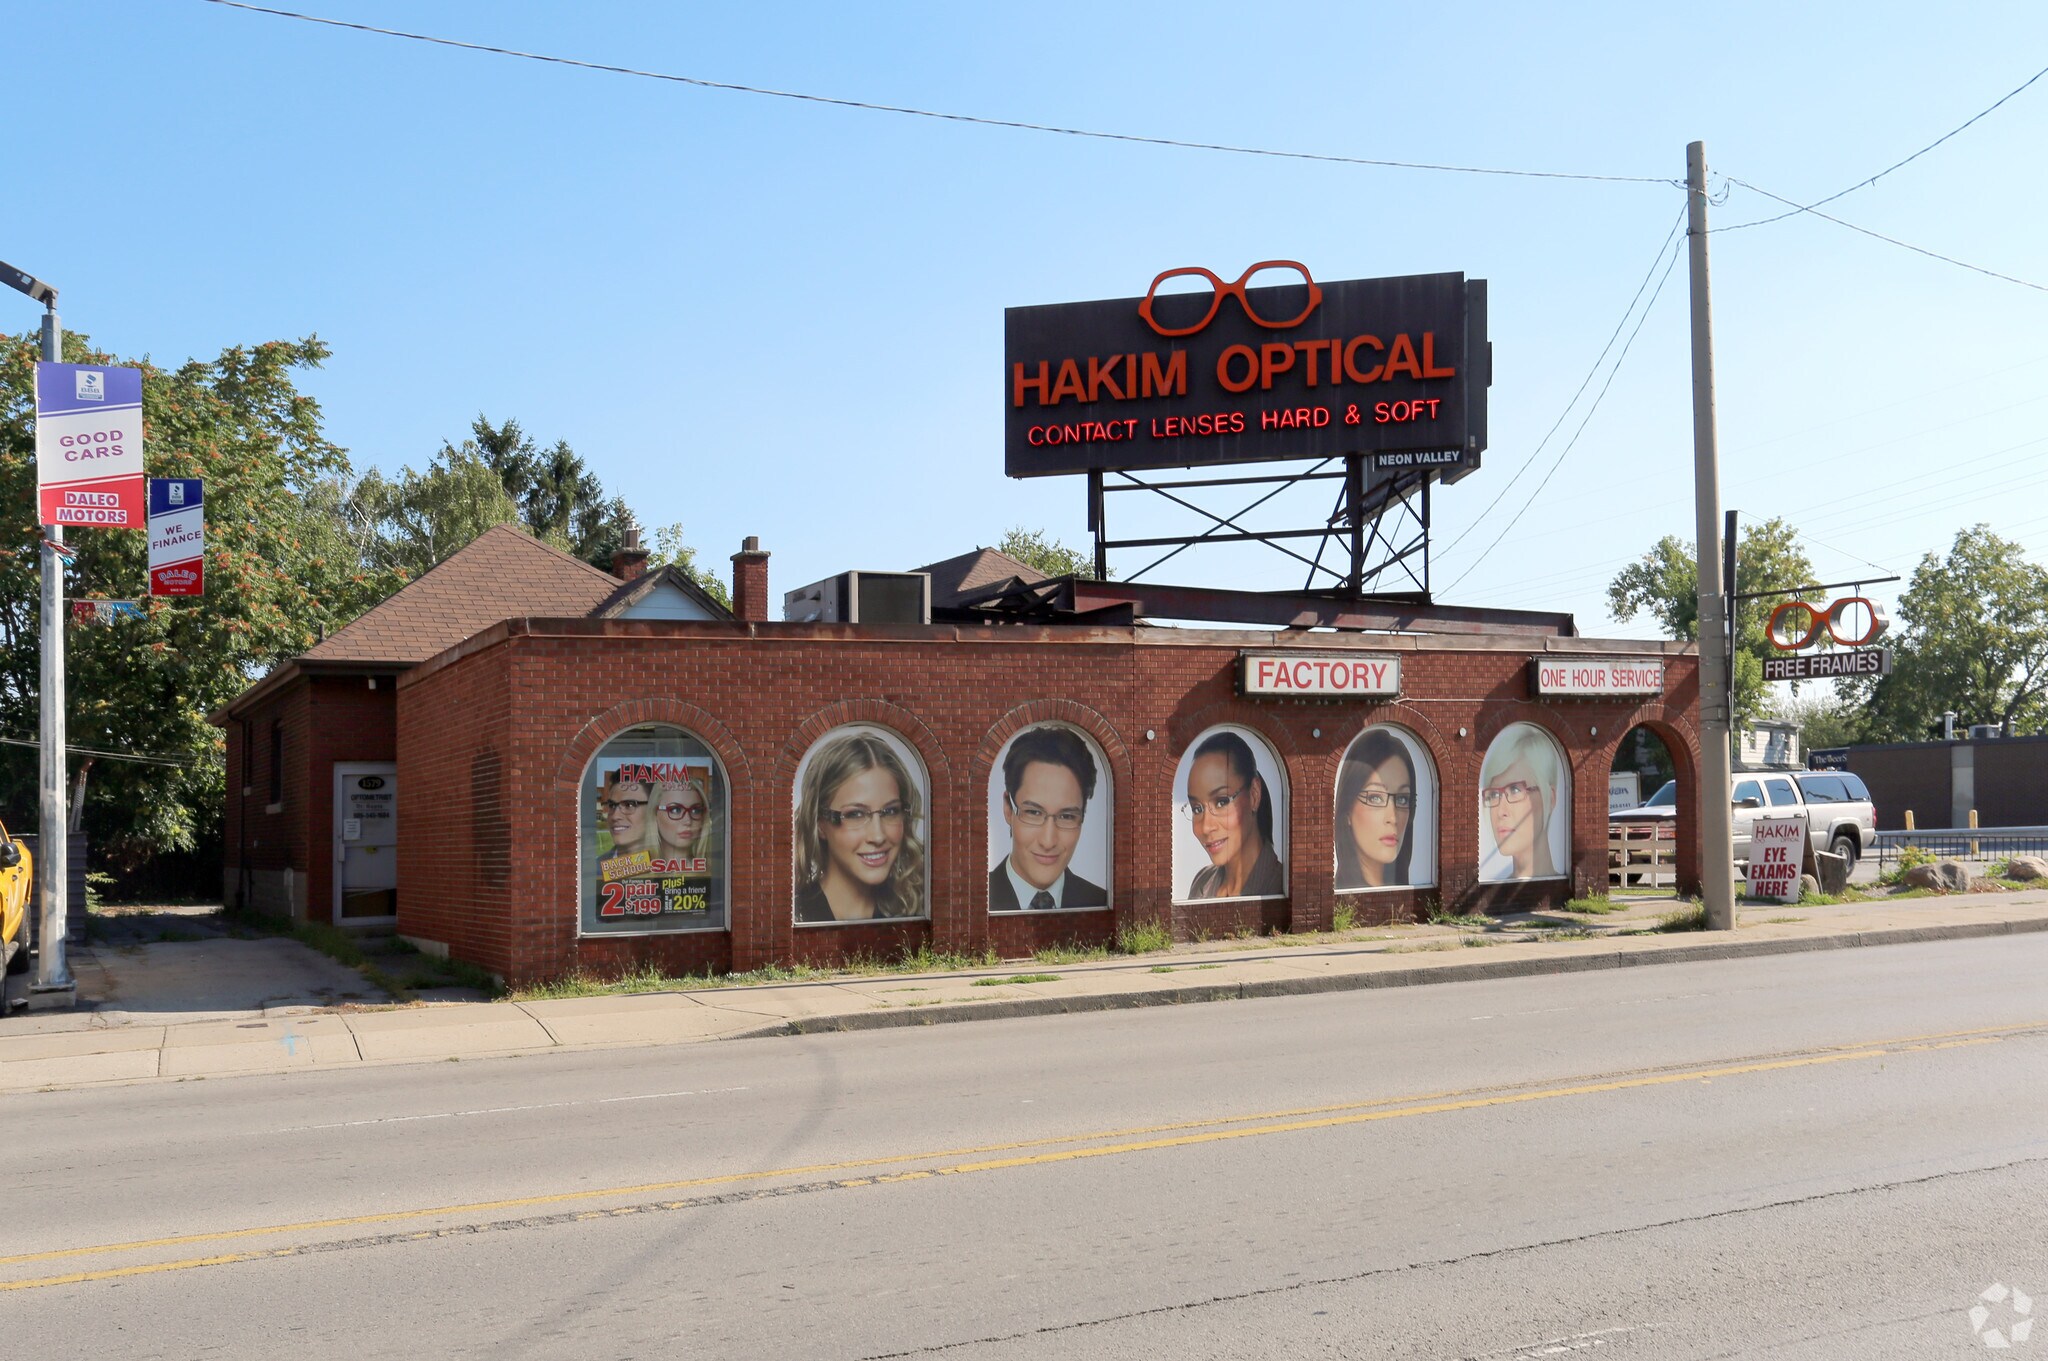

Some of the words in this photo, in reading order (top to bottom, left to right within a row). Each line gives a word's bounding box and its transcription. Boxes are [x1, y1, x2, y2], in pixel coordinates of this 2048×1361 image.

[1013, 349, 1187, 408] HAKIM
[1216, 331, 1456, 393] OPTICAL
[1028, 418, 1139, 447] CONTACT
[1152, 411, 1245, 438] LENSES
[1262, 406, 1330, 431] HARD
[1344, 404, 1361, 425] &
[1375, 399, 1441, 422] SOFT
[59, 430, 124, 447] GOOD
[64, 444, 124, 462] CARS
[1379, 454, 1413, 466] NEON
[1415, 451, 1460, 464] VALLEY
[66, 493, 118, 507] DALEO
[58, 508, 127, 523] MOTORS
[165, 524, 183, 536] WE
[152, 530, 202, 550] FINANCE
[158, 569, 198, 582] DALEO
[1765, 657, 1806, 679] FREE
[1809, 652, 1880, 676] FRAMES
[1258, 661, 1388, 690] FACTORY
[1540, 668, 1567, 689] ONE
[1572, 668, 1607, 688] HOUR
[1611, 668, 1662, 688] SERVICE
[619, 763, 690, 784] HAKIM
[1756, 824, 1800, 839] HAKIM
[603, 856, 632, 871] BACK
[1764, 847, 1788, 863] EYE
[609, 862, 650, 879] SCHOOL
[650, 858, 707, 873] SALE
[1751, 863, 1797, 880] EXAMS
[662, 875, 685, 890] Plus!
[665, 887, 682, 896] Bring
[688, 886, 707, 894] friend
[1755, 880, 1789, 897] HERE
[600, 881, 625, 917] 2
[625, 879, 659, 900] pair
[625, 898, 662, 915] $199
[673, 893, 706, 911] 20%
